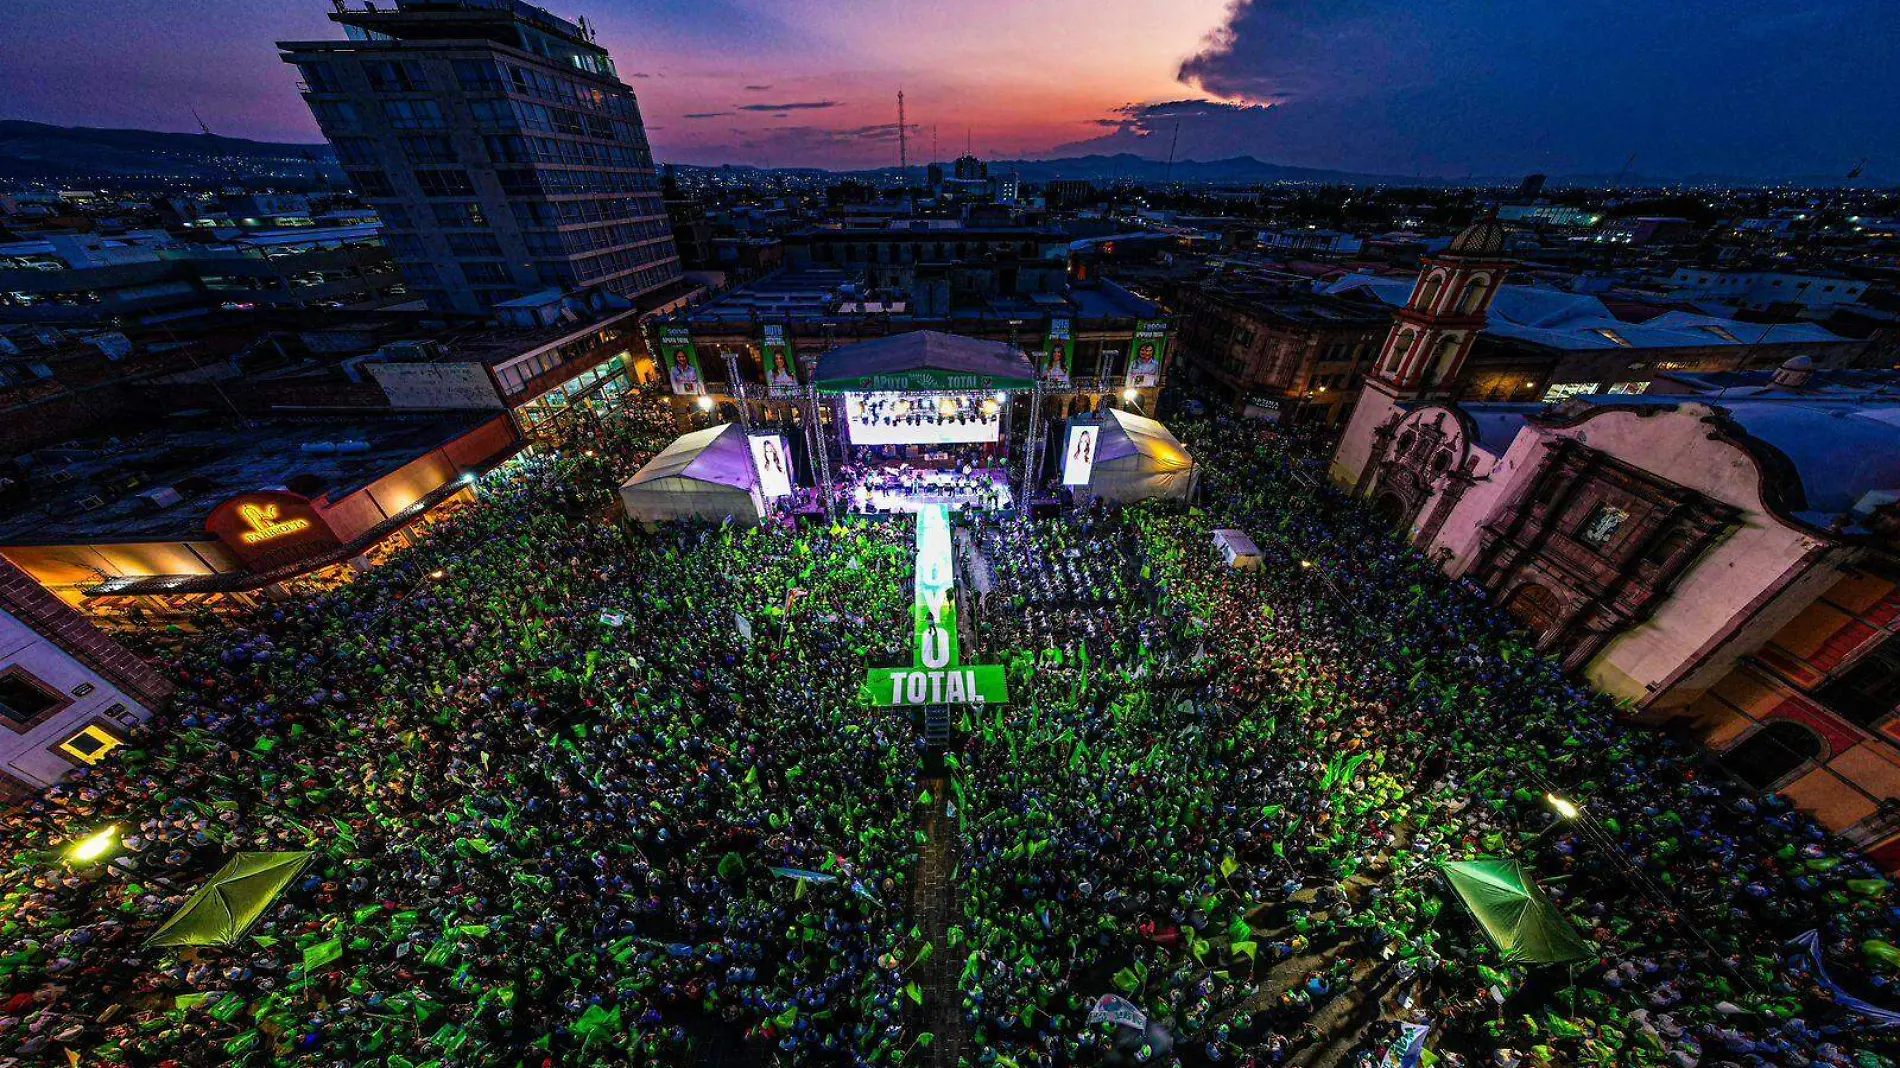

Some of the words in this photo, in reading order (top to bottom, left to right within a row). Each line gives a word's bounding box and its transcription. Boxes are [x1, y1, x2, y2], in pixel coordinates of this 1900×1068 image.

[873, 375, 908, 388] APOYO
[947, 375, 977, 388] TOTAL
[890, 670, 985, 705] TOTAL
